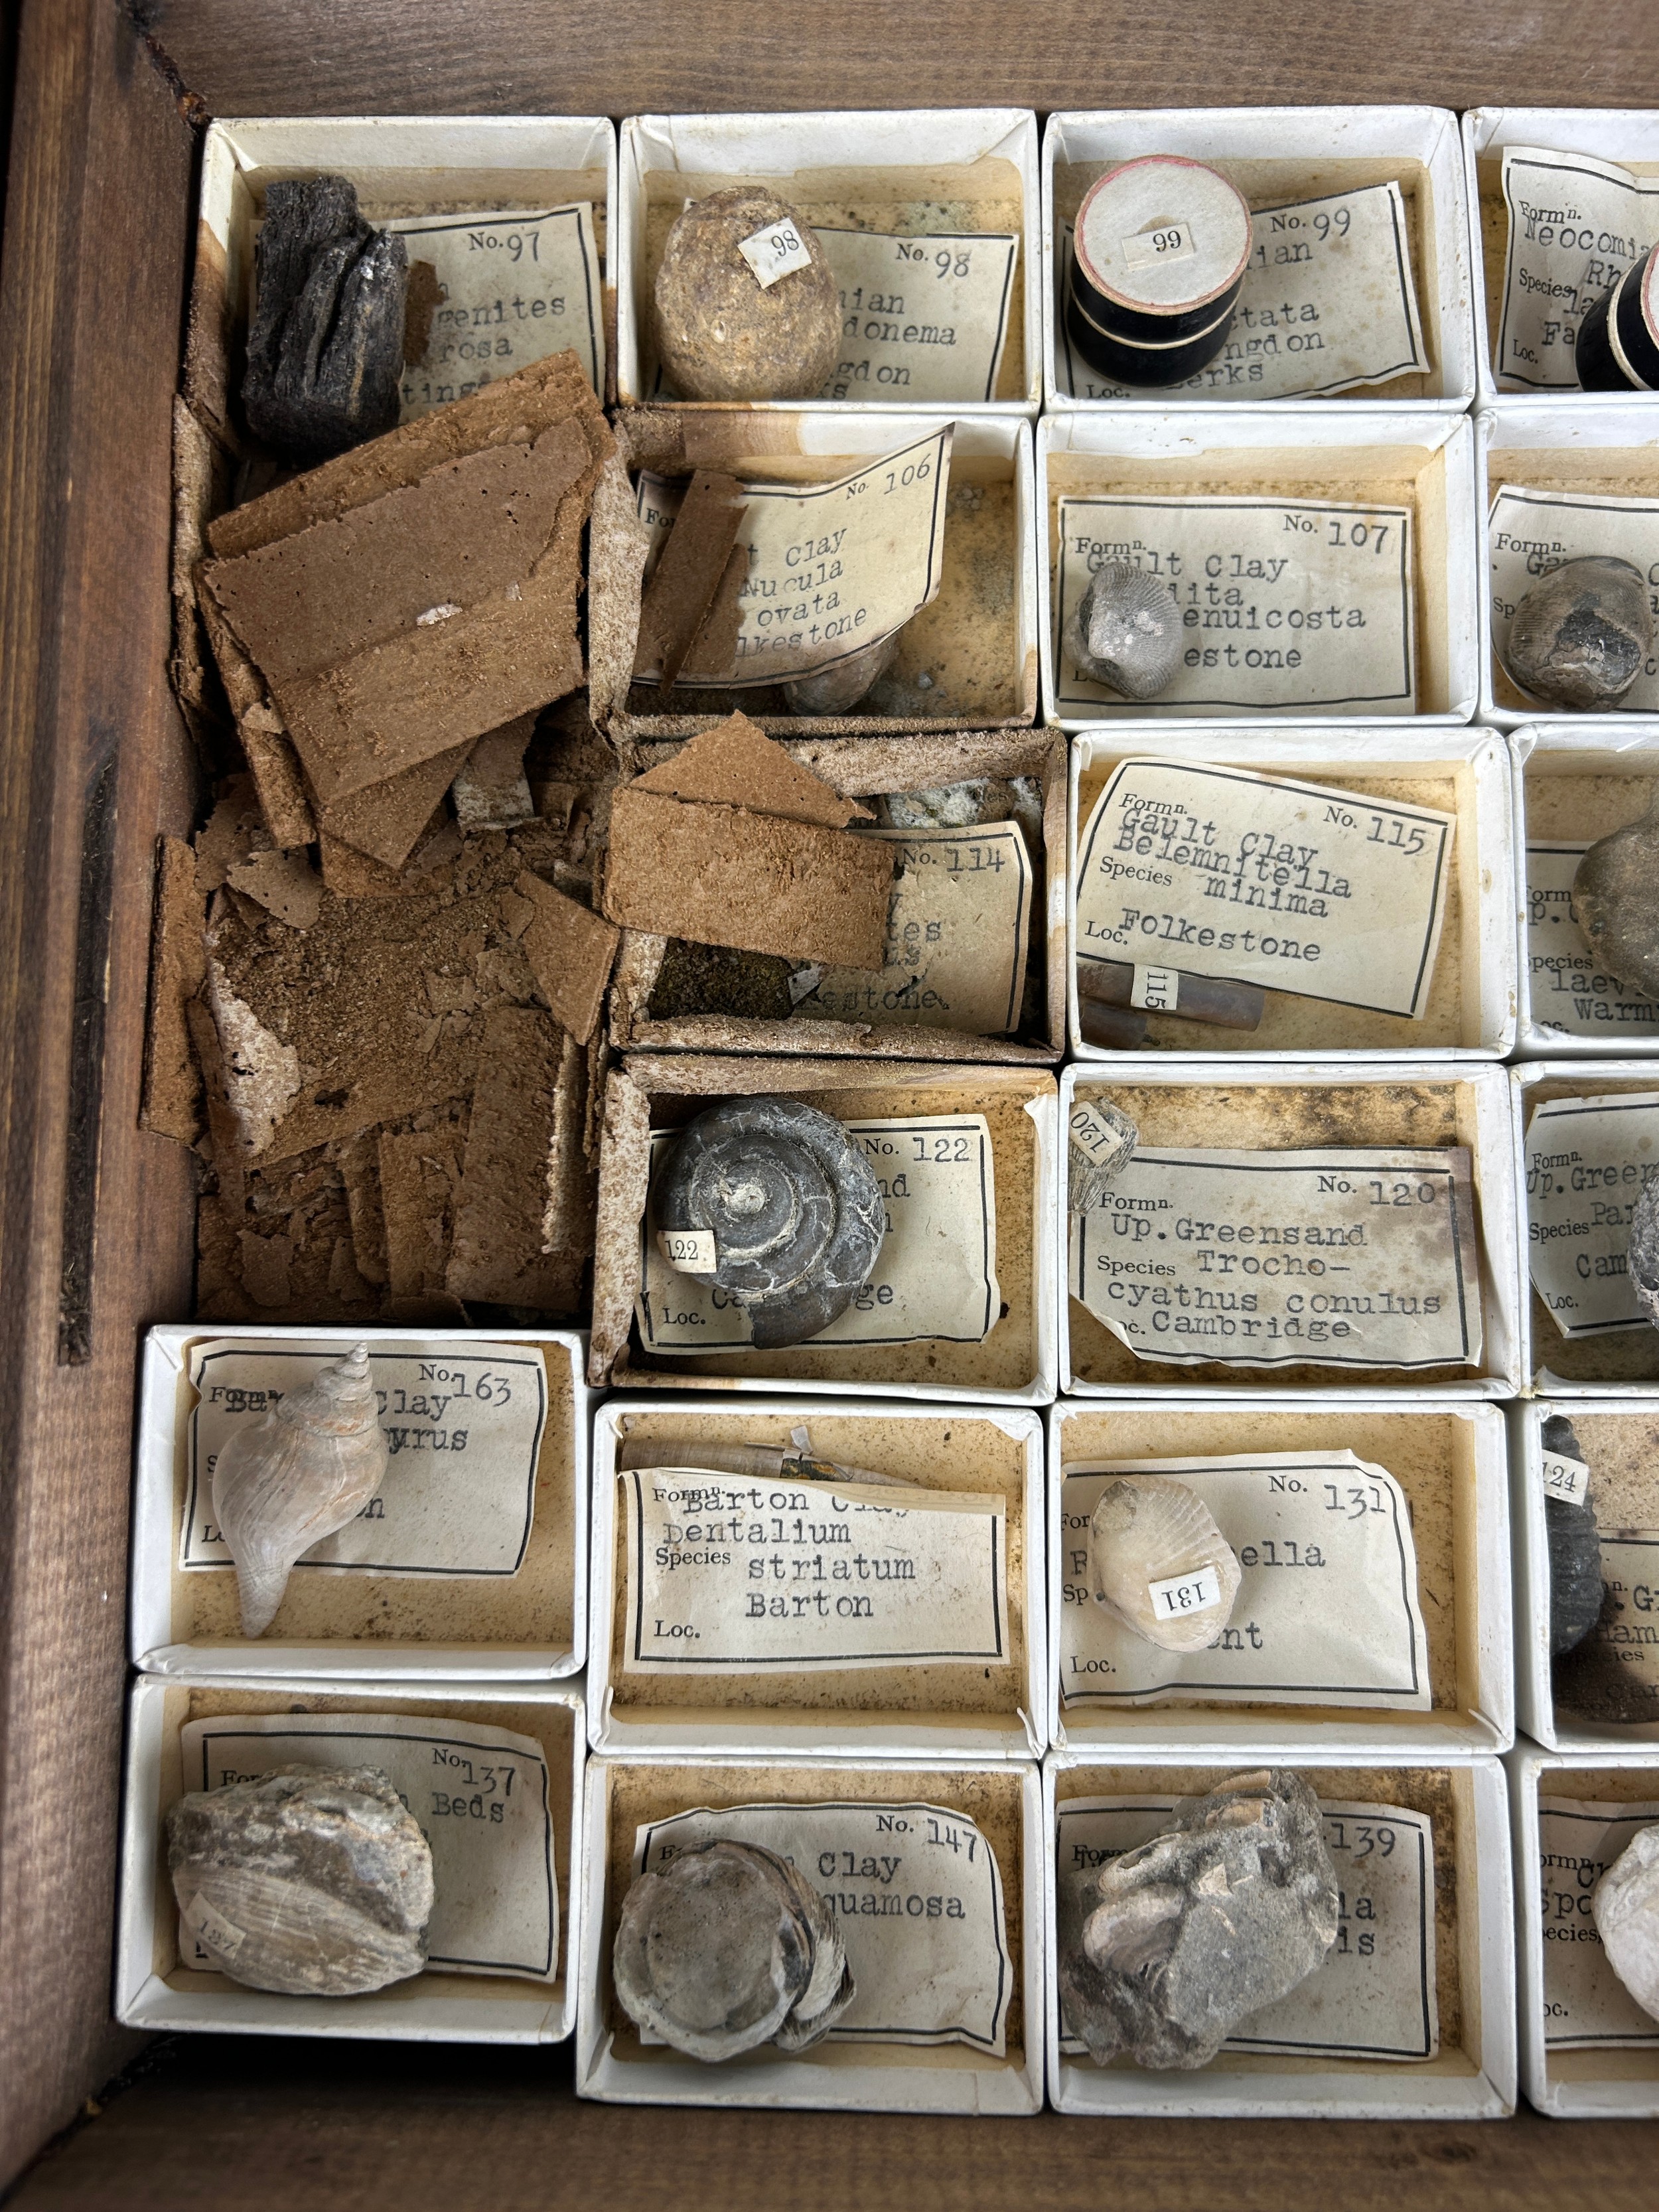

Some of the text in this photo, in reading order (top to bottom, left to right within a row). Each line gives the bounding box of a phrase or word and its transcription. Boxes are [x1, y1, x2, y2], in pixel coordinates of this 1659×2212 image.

[1271, 208, 1351, 241] No. 99
[469, 232, 540, 262] No. 97
[771, 230, 800, 257] 98
[1153, 230, 1181, 254] 99
[896, 244, 970, 279] No. 98
[1519, 267, 1572, 299] Species
[1512, 339, 1538, 364] Loc.
[1086, 362, 1264, 399] Loc. erks
[883, 453, 930, 495] 106
[786, 528, 847, 567] Clay
[1283, 514, 1389, 553] No. 107
[1204, 555, 1288, 582] Clay
[757, 589, 839, 627] ovata
[1121, 808, 1216, 846] Gault
[1323, 806, 1426, 855] No. 115
[946, 847, 1005, 873] 114
[1100, 856, 1173, 887] Species
[1203, 874, 1329, 918] minima
[1084, 920, 1128, 945] Loc.
[1119, 908, 1321, 962] Folkestone
[1145, 971, 1167, 1009] 115
[1573, 997, 1659, 1021] Warm
[1070, 1111, 1110, 1153] 120
[865, 1137, 970, 1163] No. 122
[1317, 1175, 1437, 1207] No. 120
[1530, 1218, 1589, 1244] Species
[664, 1239, 699, 1262] 122
[1097, 1255, 1176, 1277] Species
[1108, 1281, 1442, 1315] cyathus conulus
[1546, 1291, 1578, 1310] Loc.
[663, 1308, 707, 1327] Loc.
[1152, 1311, 1351, 1342] Cambridge
[453, 1370, 512, 1406] 163
[1269, 1475, 1386, 1520] No. 131
[655, 1546, 916, 1580] Species striatum
[1232, 1540, 1327, 1568] ella
[745, 1593, 874, 1618] Barton
[1161, 1580, 1207, 1612] 131
[654, 1620, 701, 1639] Loc.
[1070, 1656, 1116, 1674] Loc.
[462, 1761, 516, 1797] 137
[432, 1793, 505, 1823] Beds
[875, 1815, 978, 1862] No. 147
[1331, 1823, 1396, 1858] 139
[818, 1851, 902, 1883] Clay
